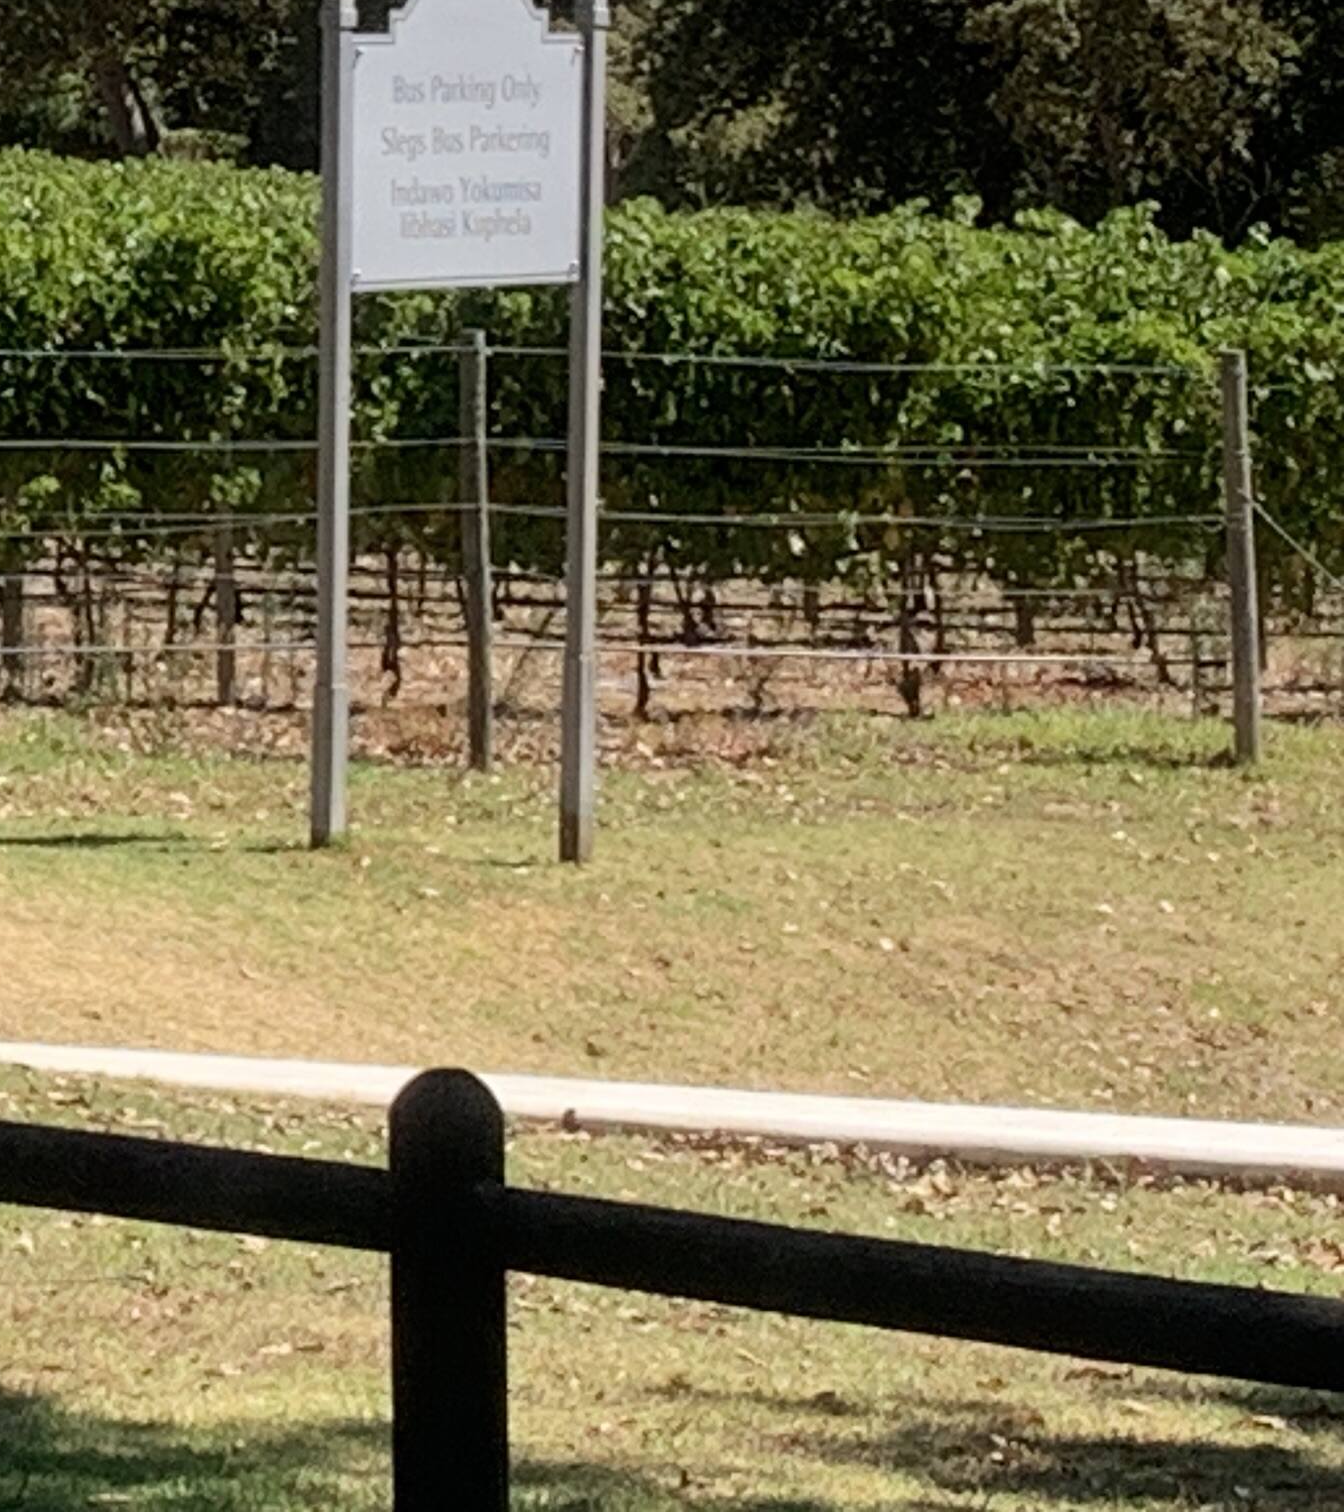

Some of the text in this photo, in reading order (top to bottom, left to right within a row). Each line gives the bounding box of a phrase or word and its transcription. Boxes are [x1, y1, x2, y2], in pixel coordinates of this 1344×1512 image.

[392, 73, 541, 110] Bus Parking Only
[381, 125, 550, 162] Slegs Bus Parkering
